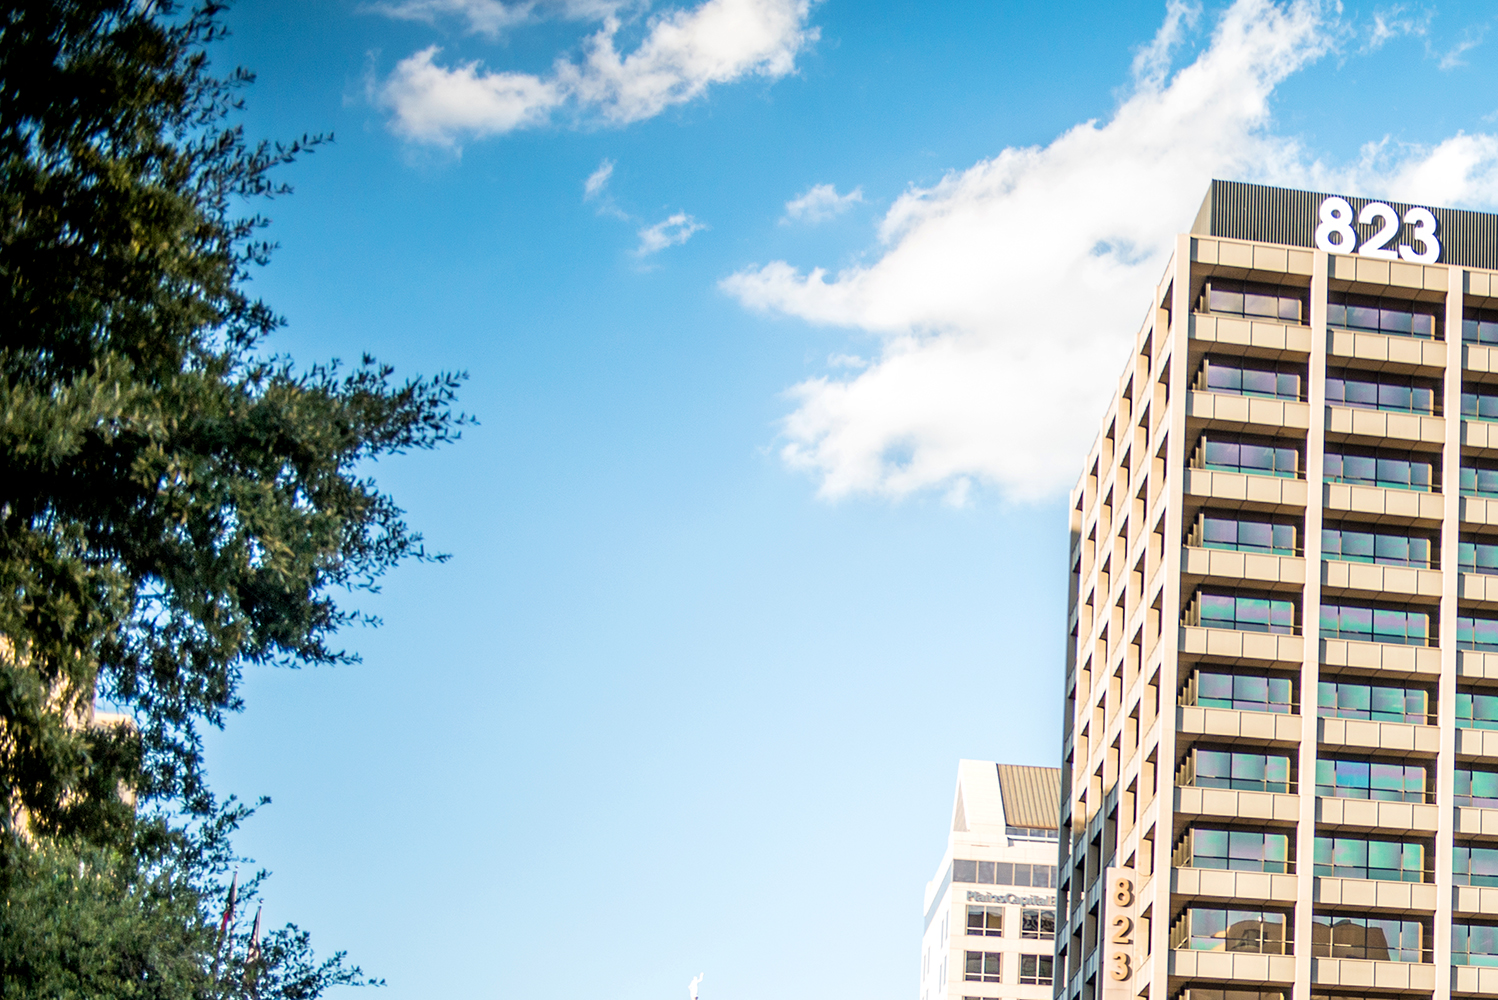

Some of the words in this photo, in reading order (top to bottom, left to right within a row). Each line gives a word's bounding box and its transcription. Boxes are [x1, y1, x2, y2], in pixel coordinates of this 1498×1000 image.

[1314, 196, 1441, 265] 823
[966, 890, 1049, 907] PlainsCapital
[1110, 877, 1133, 982] 823
